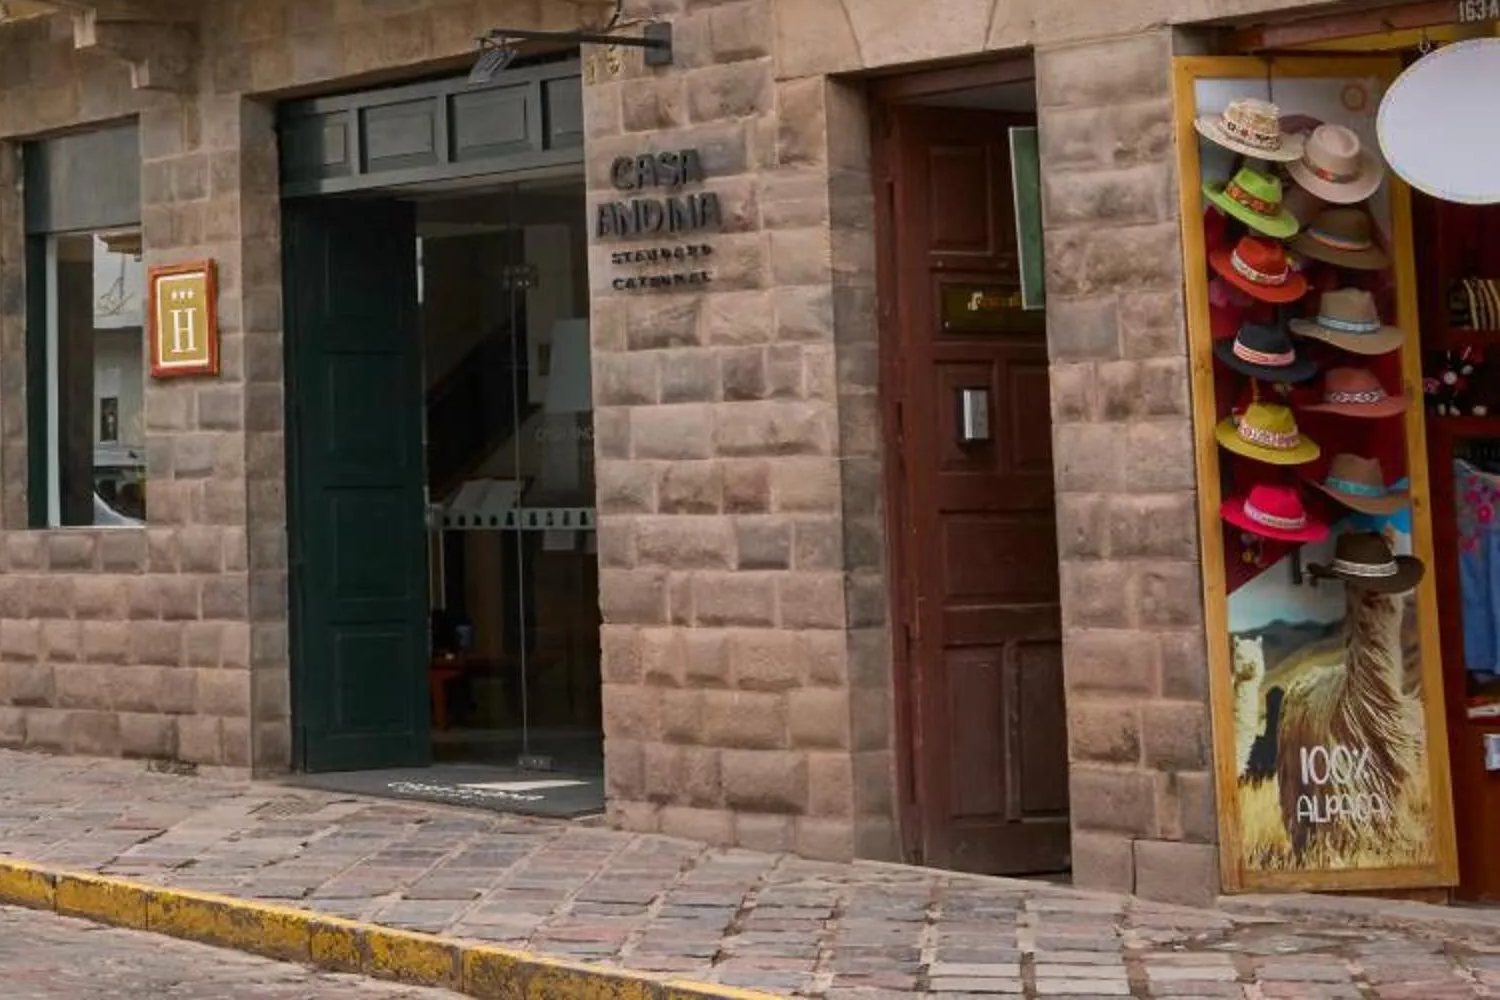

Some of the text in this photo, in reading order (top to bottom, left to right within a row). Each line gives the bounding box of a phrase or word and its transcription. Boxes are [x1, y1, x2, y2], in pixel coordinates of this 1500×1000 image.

[610, 149, 704, 190] CASA
[596, 192, 721, 239] ANDINA
[612, 243, 712, 265] STANDARD
[169, 307, 197, 354] H
[1299, 745, 1371, 785] 100%
[1297, 792, 1384, 823] ALPACA
